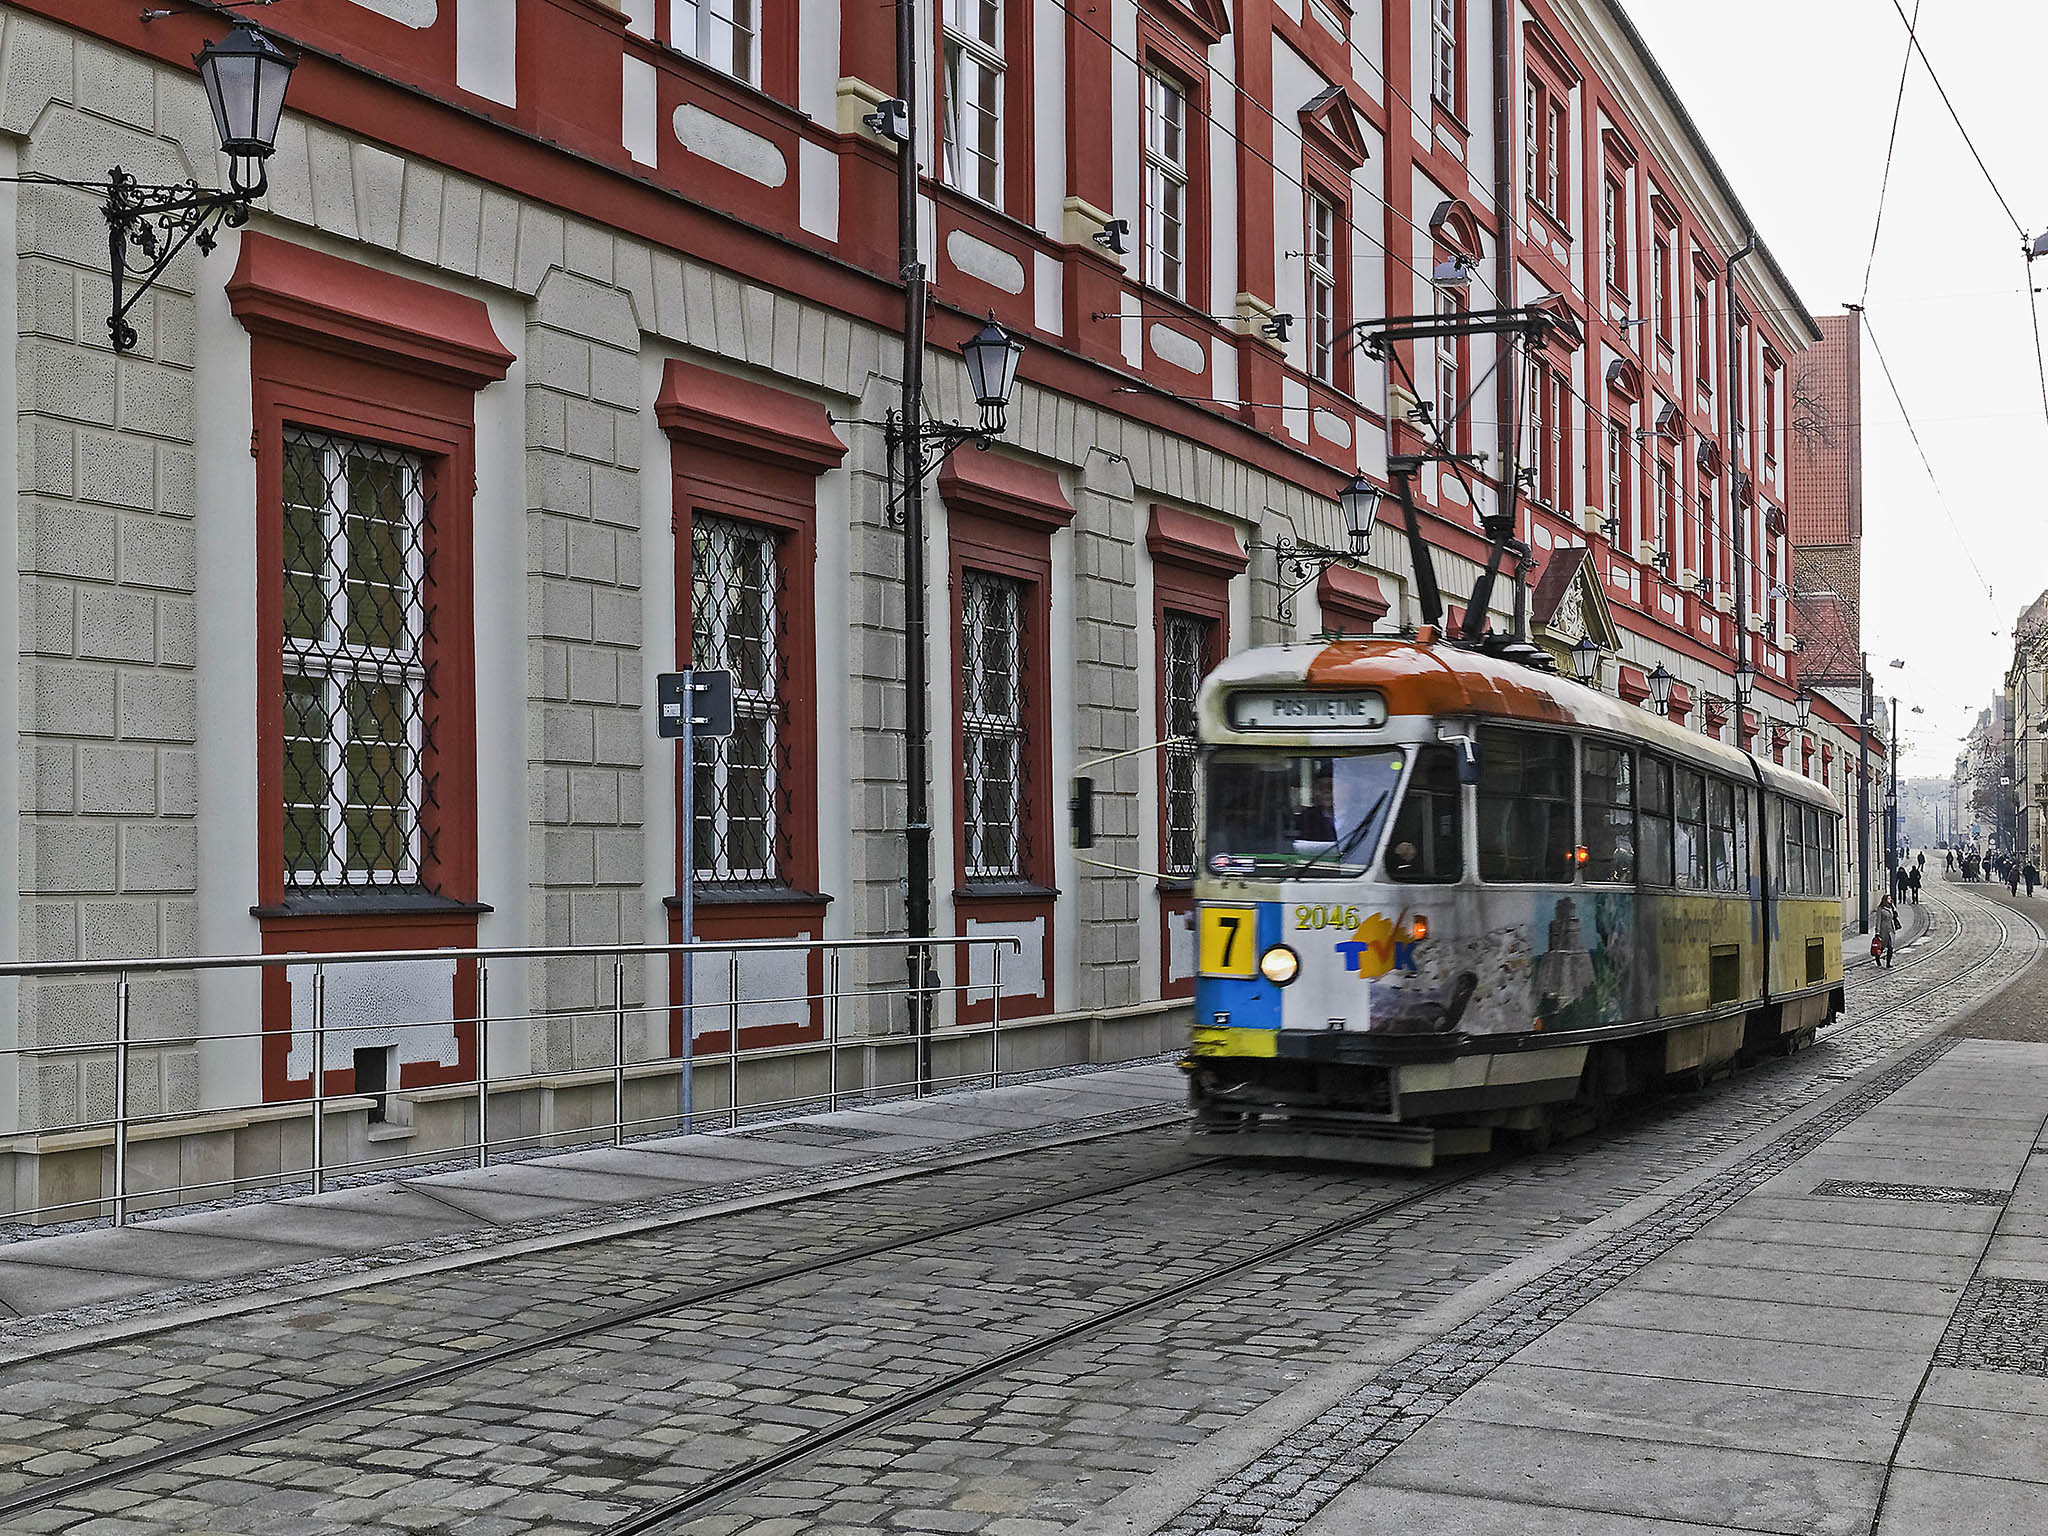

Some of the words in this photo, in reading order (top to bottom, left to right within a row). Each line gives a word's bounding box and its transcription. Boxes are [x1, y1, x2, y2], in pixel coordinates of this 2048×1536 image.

[1219, 917, 1242, 968] 7
[1295, 904, 1360, 931] 2046
[1335, 910, 1418, 972] TVK
